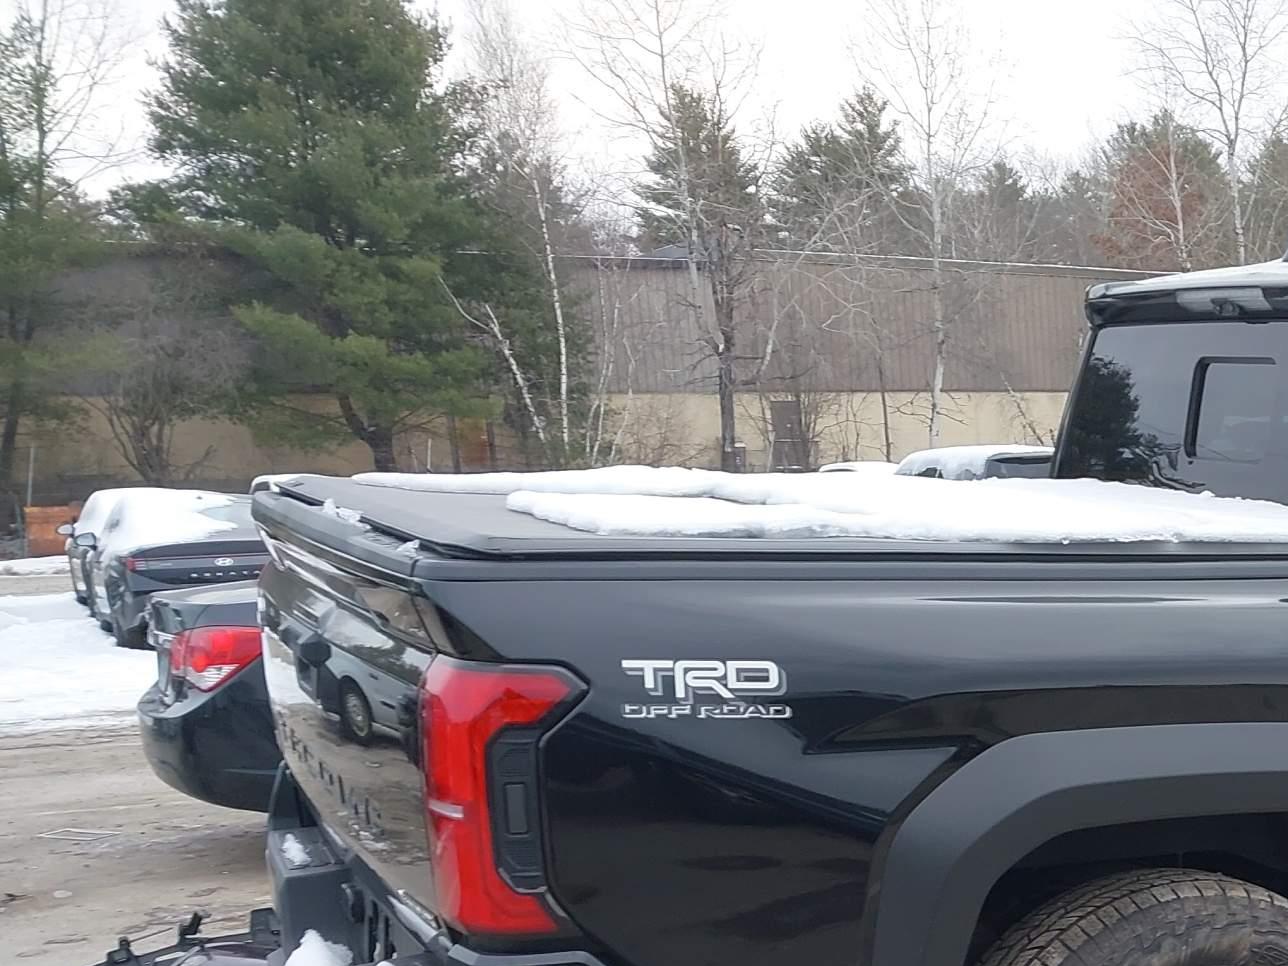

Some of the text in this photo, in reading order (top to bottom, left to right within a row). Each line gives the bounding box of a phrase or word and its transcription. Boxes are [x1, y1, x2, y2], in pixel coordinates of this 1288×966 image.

[621, 659, 787, 704] TRD
[622, 703, 793, 719] OFF ROAD
